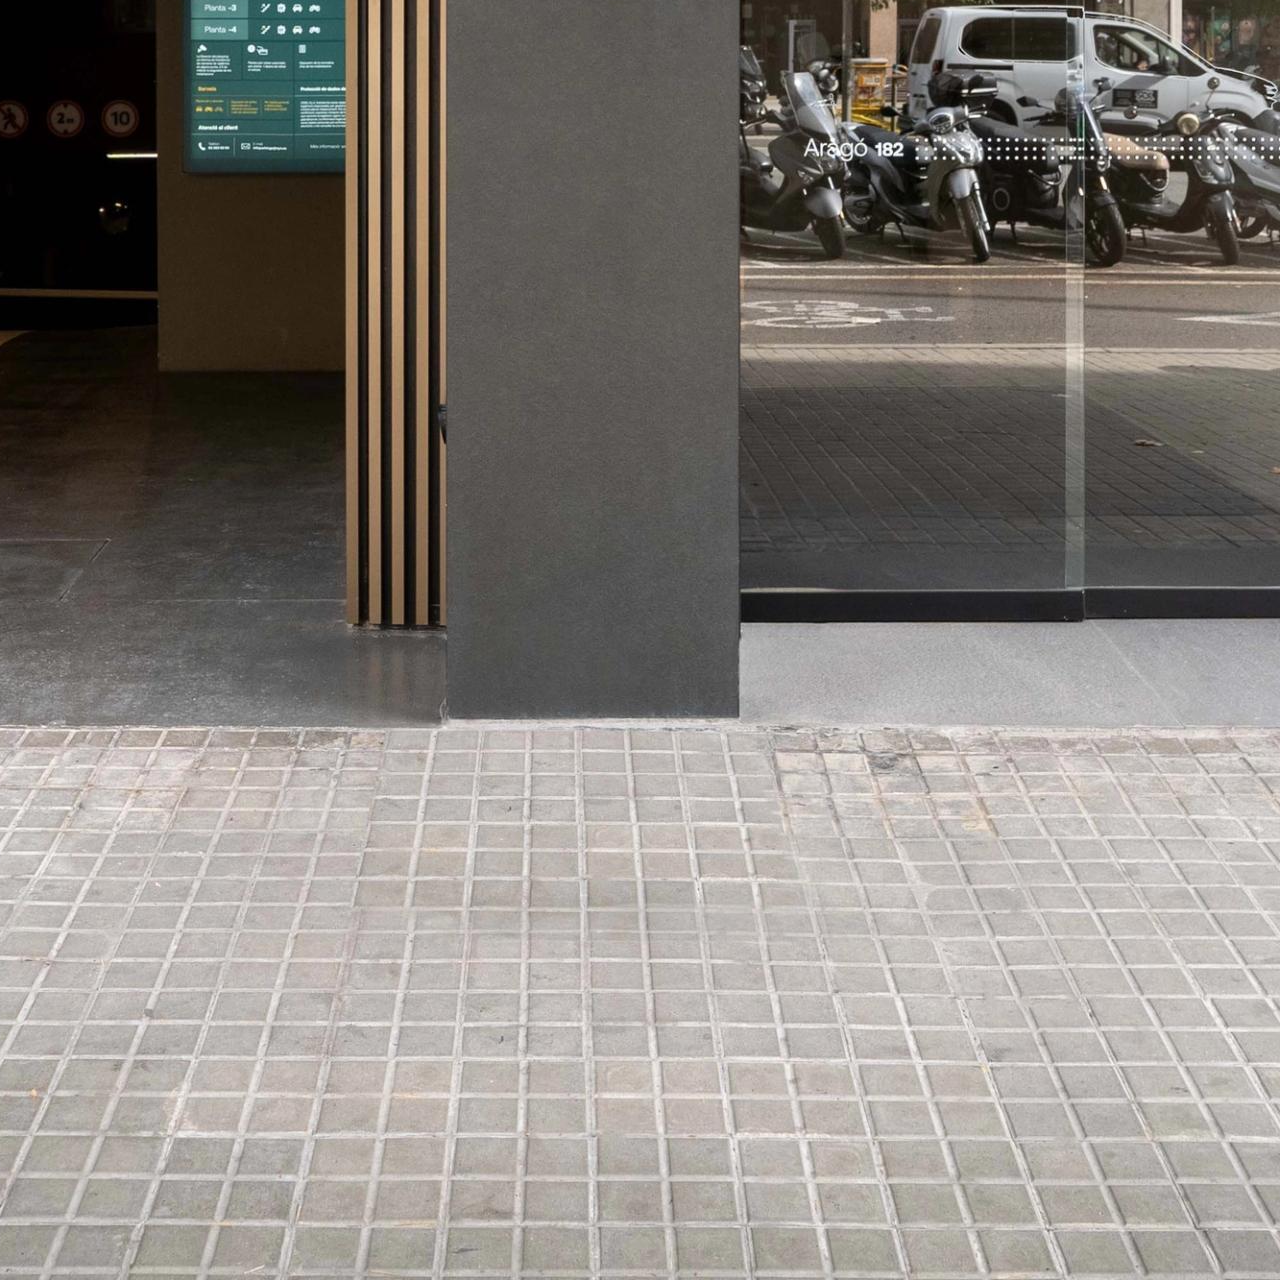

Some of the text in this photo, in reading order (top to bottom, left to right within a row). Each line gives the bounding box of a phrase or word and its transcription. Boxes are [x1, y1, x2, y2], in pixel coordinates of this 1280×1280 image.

[204, 4, 226, 12] Planta
[204, 25, 226, 33] Planta
[110, 111, 131, 126] 10
[804, 137, 904, 162] Aragó 182
